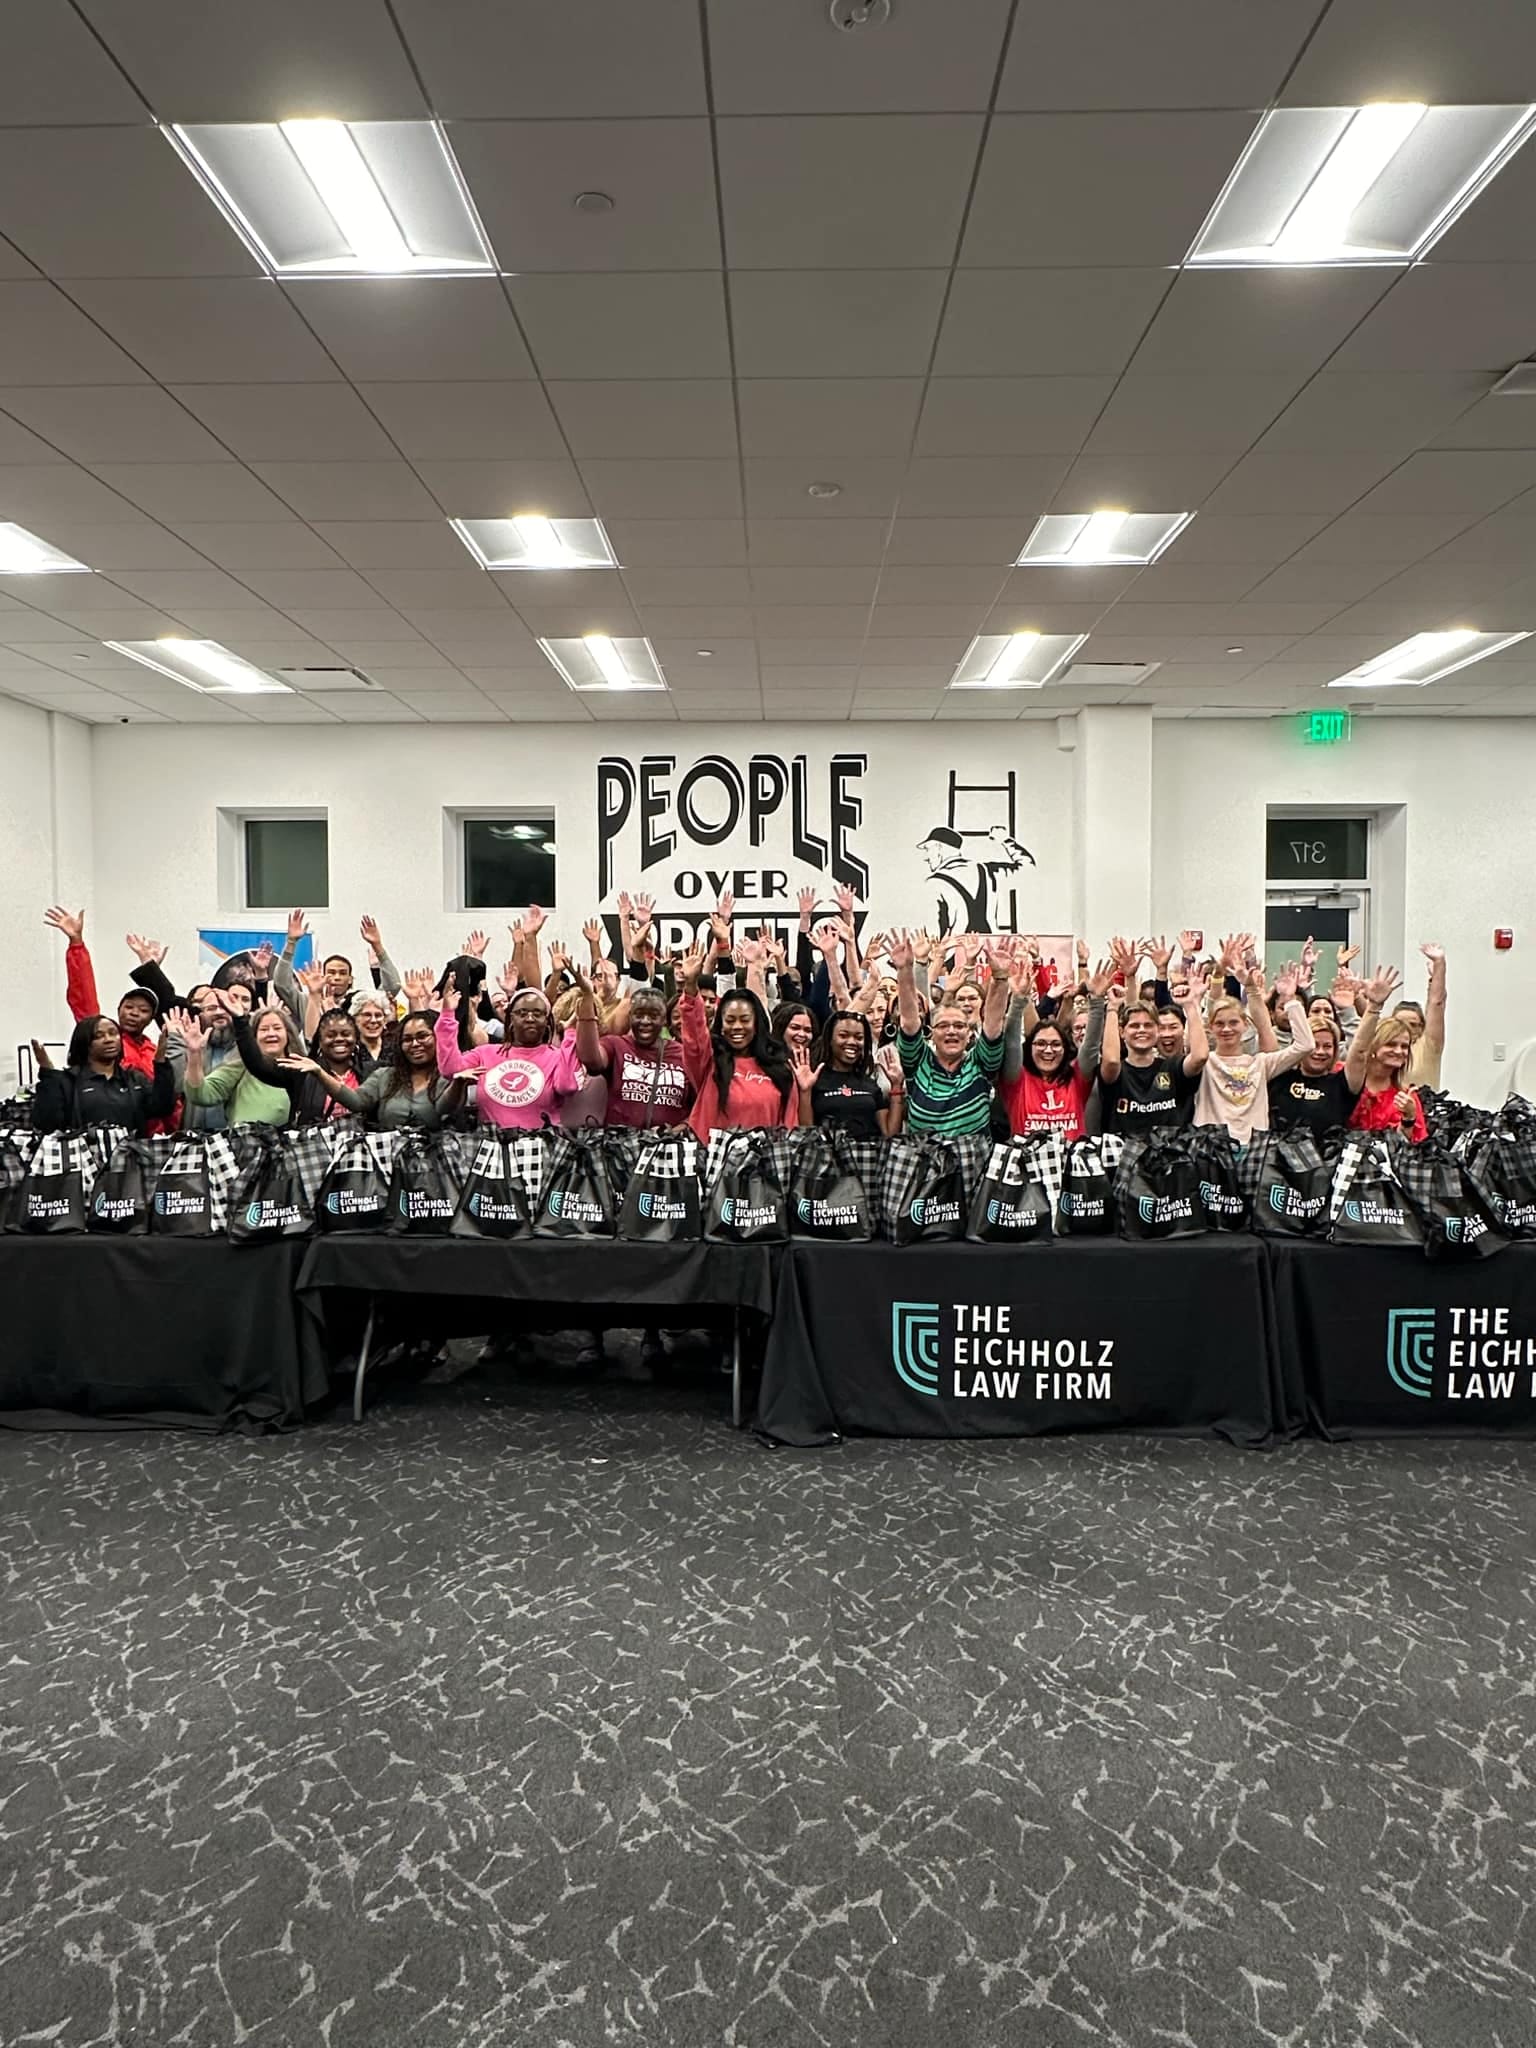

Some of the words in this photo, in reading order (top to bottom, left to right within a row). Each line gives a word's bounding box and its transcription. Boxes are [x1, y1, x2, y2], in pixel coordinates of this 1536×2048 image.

[1311, 714, 1345, 741] EXIT
[597, 754, 869, 903] PEOPLE
[674, 870, 788, 899] OVER
[488, 1083, 506, 1100] THAN
[505, 1087, 538, 1104] CANCER
[622, 1082, 684, 1098] ASSOCATION
[631, 1093, 683, 1108] EDUATORS
[1130, 1098, 1177, 1113] Piedmont
[1210, 1184, 1221, 1193] HE
[166, 1191, 182, 1200] THE
[408, 1191, 426, 1201] THE
[480, 1194, 494, 1204] THE
[564, 1191, 580, 1202] THE
[653, 1194, 667, 1204] THE
[103, 1199, 136, 1210] HHOLZ
[166, 1197, 205, 1207] EICHHOLZ
[408, 1200, 452, 1210] EICHHOLZ
[480, 1202, 516, 1213] EICHHOLZ
[735, 1198, 749, 1208] THE
[813, 1199, 828, 1209] THE
[1361, 1200, 1377, 1209] THE
[48, 1207, 70, 1217] FIRM
[112, 1207, 135, 1218] FIRM
[165, 1206, 183, 1216] LAW
[184, 1204, 205, 1214] FIRM
[409, 1209, 429, 1219] LAW
[431, 1208, 454, 1217] FIRM
[480, 1211, 498, 1220] LAW
[500, 1210, 518, 1220] FIRM
[652, 1210, 669, 1220] LAW
[669, 1210, 686, 1220] FIRM
[735, 1205, 776, 1218] EICHHOLZ
[813, 1205, 858, 1218] EICHHOLZ
[1072, 1208, 1087, 1217] AW
[1087, 1208, 1105, 1217] FIRM
[1154, 1213, 1172, 1223] LAW
[1172, 1208, 1193, 1221] FIRM
[1286, 1206, 1305, 1217] LAW
[1361, 1207, 1404, 1217] EICHHOLZ
[561, 1210, 580, 1221] LAW
[582, 1212, 604, 1222] FIRM
[734, 1216, 752, 1227] LAW
[754, 1215, 777, 1226] FIRM
[813, 1216, 833, 1226] LAW
[835, 1215, 858, 1225] FIRM
[924, 1214, 940, 1225] LAW
[941, 1211, 960, 1222] FIRM
[1363, 1215, 1384, 1224] LAW
[1384, 1215, 1404, 1225] FIRM
[259, 1217, 278, 1228] LAW
[953, 1304, 1011, 1333] THE
[1449, 1307, 1510, 1335] THE
[954, 1337, 1114, 1368] EICHHOLZ
[953, 1370, 1021, 1399] LAW
[1035, 1372, 1111, 1400] FIRM
[1447, 1371, 1516, 1399] LAW
